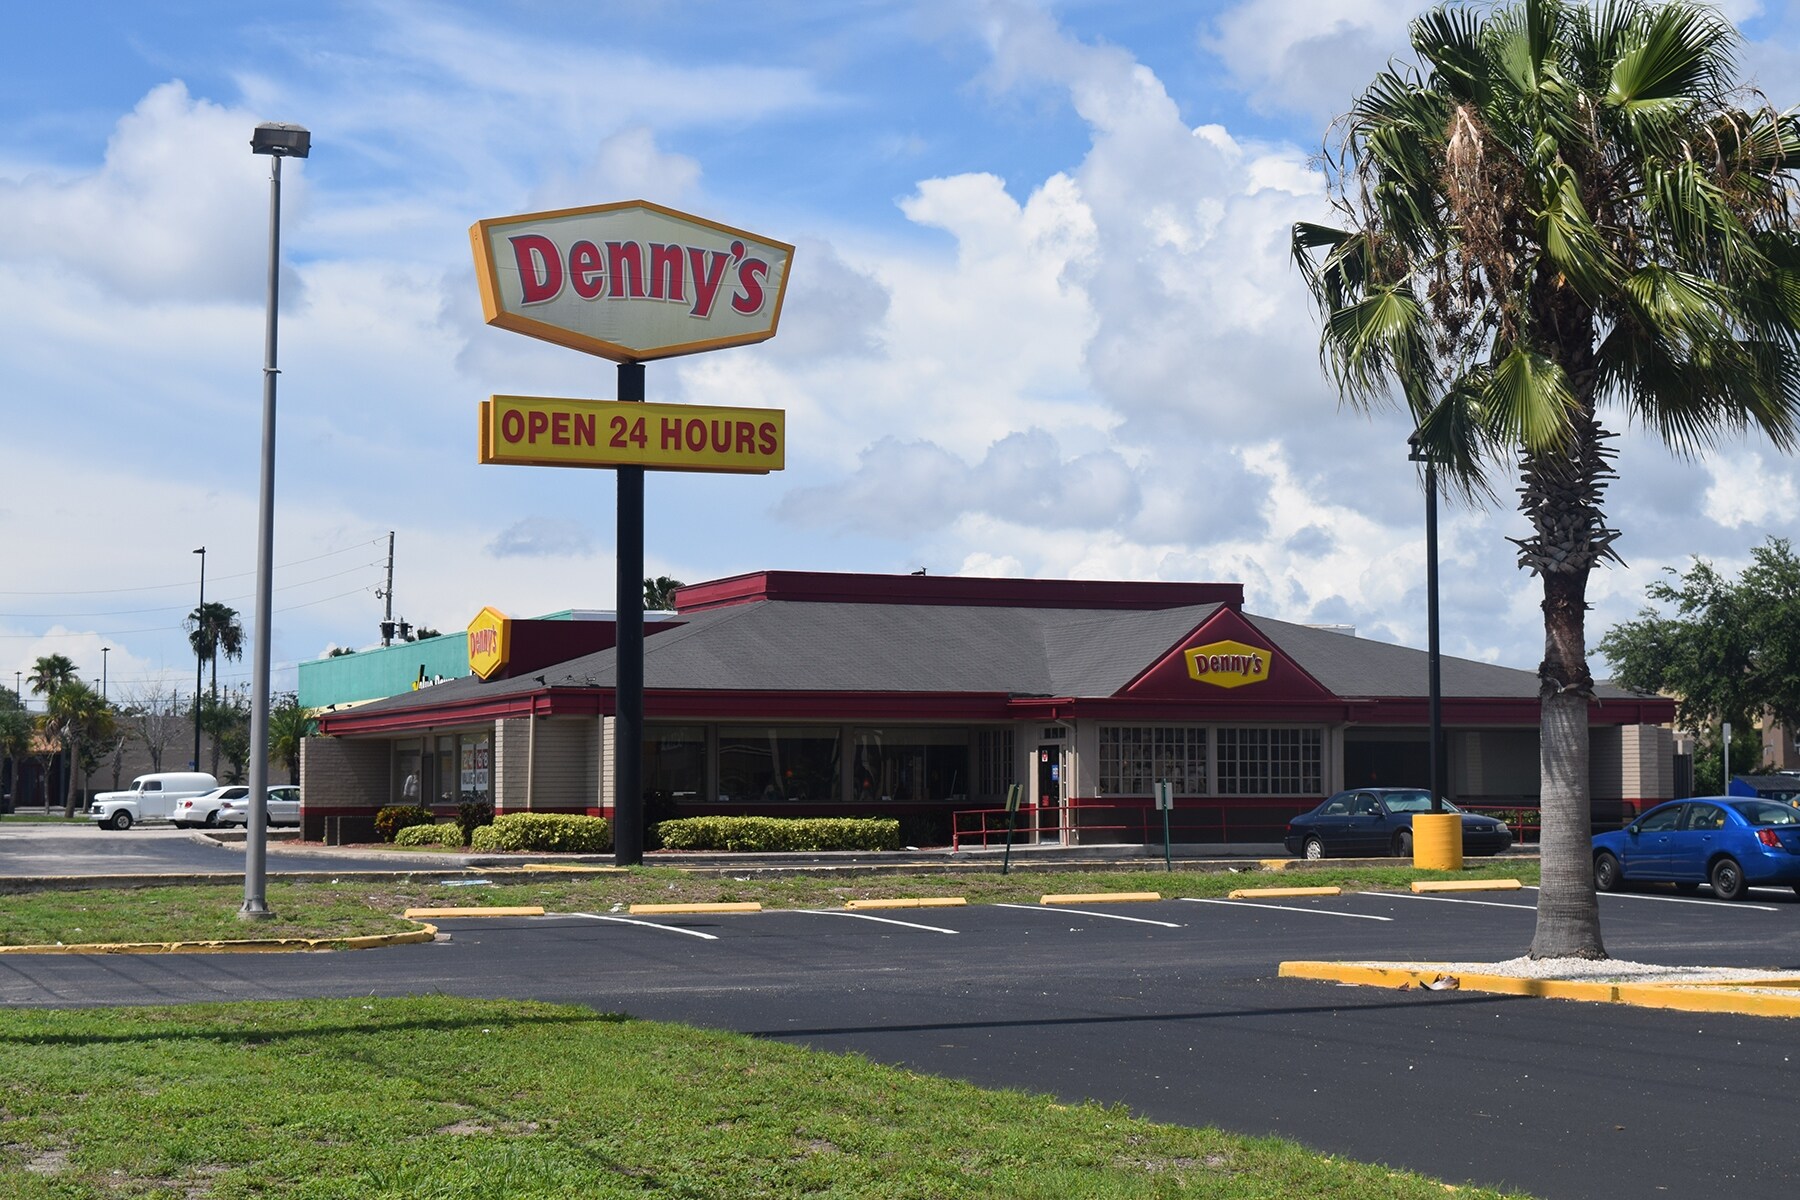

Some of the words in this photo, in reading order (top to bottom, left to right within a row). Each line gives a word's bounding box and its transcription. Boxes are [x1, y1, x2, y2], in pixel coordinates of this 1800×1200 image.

[507, 234, 768, 318] Denny's
[501, 409, 596, 447] OPEN
[609, 415, 648, 449] 24
[660, 417, 778, 456] HOURS
[470, 624, 497, 659] Denny's
[1194, 652, 1263, 676] Denny's
